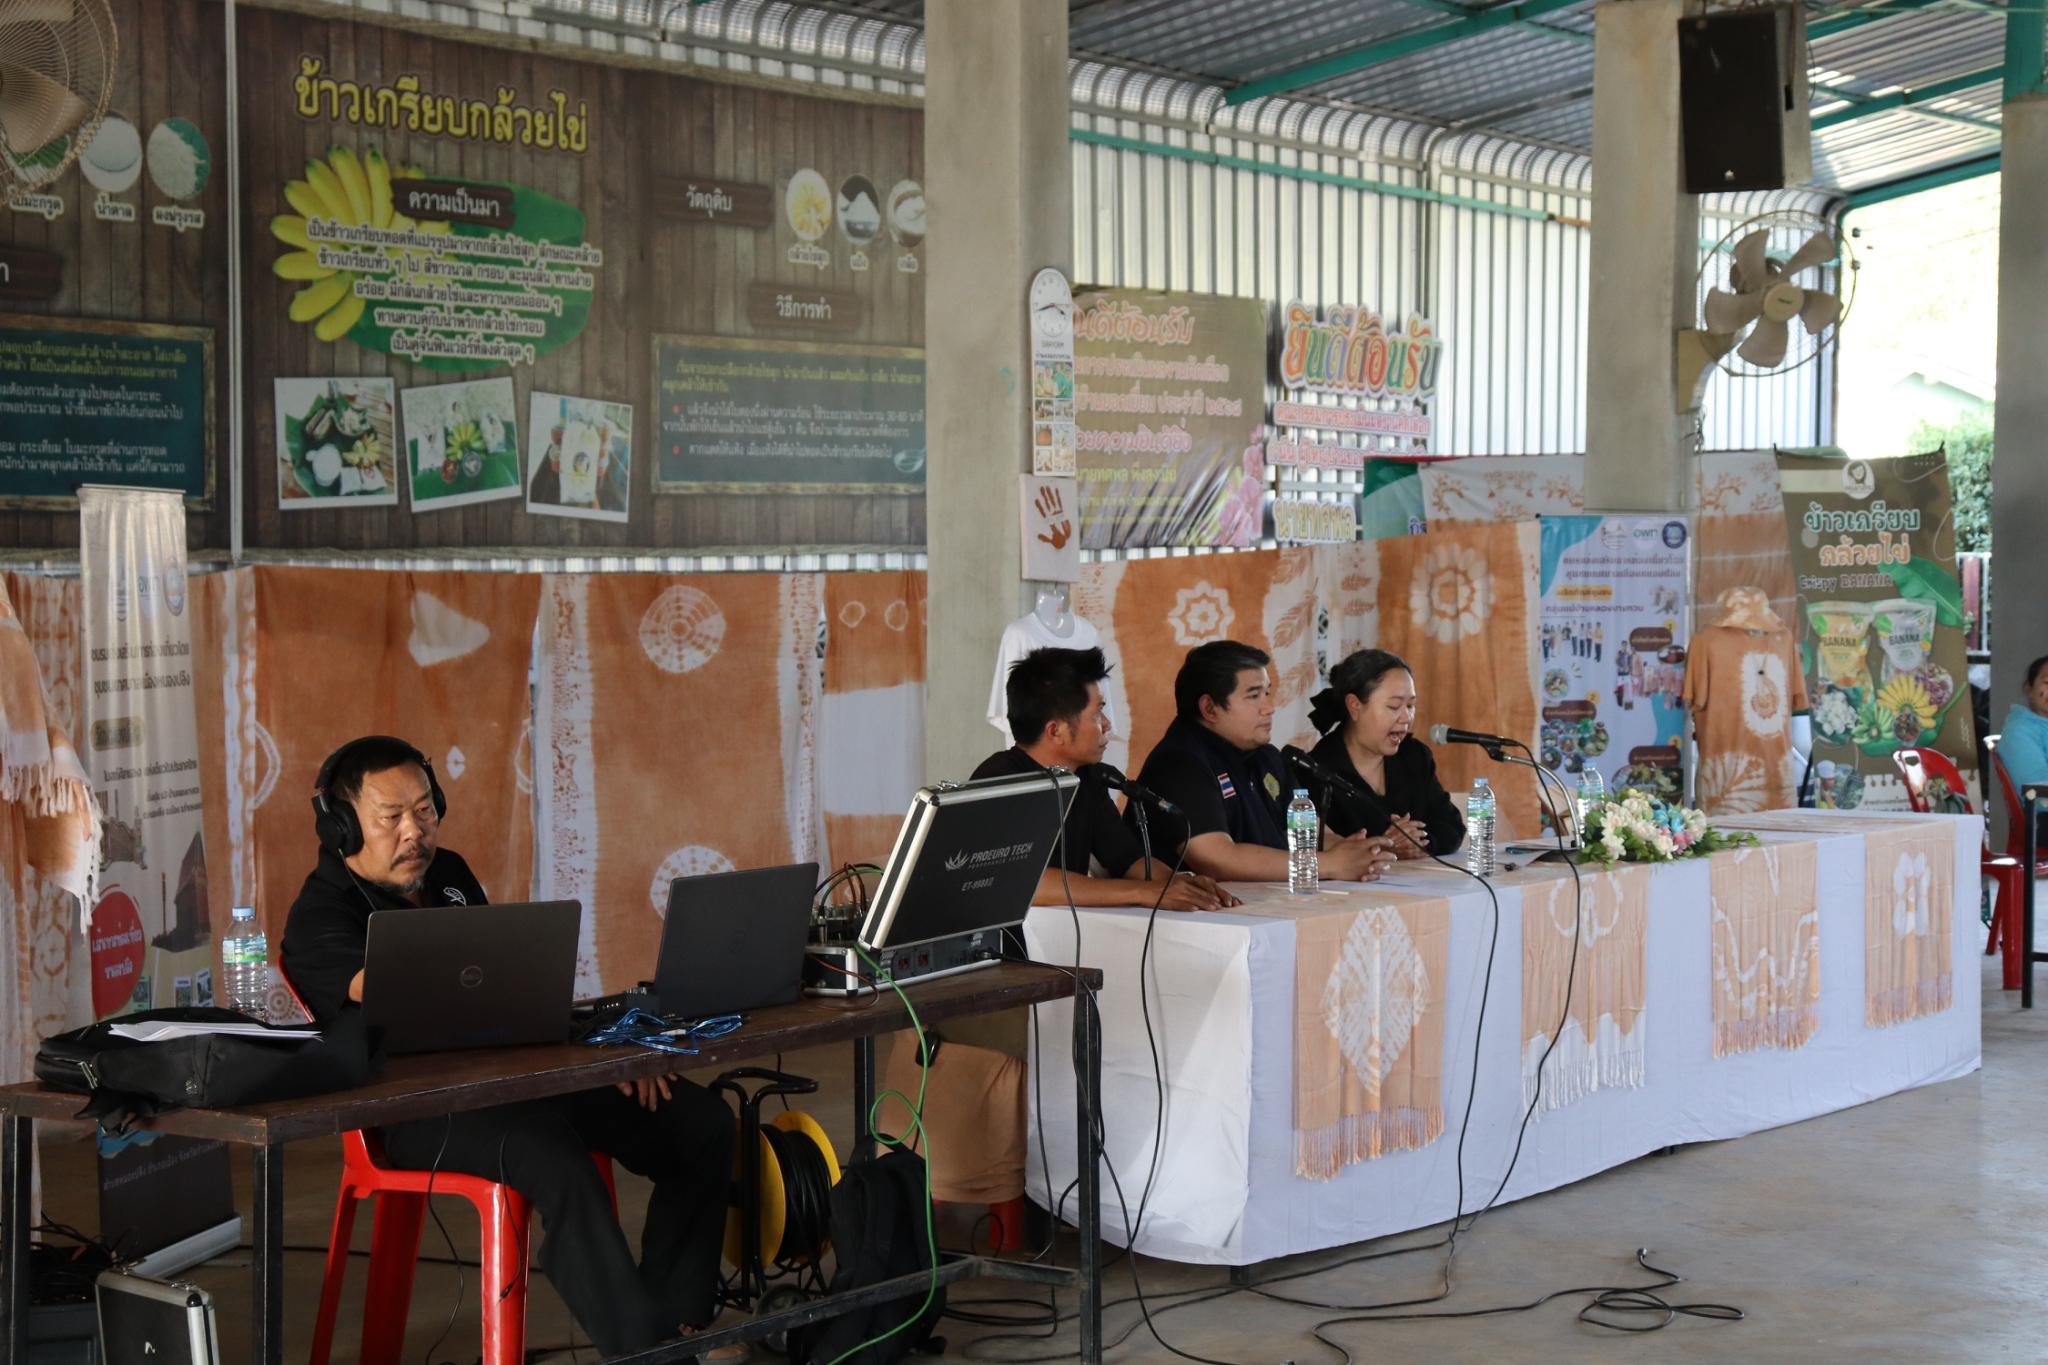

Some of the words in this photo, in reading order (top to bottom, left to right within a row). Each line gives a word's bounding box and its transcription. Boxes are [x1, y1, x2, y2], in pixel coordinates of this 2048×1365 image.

[295, 57, 588, 152] ข้าวเกรียบกล้วยไข่
[97, 193, 133, 218] น้ำตาล
[409, 187, 500, 218] ความเป็นมา
[686, 184, 732, 218] วัตถุดิบ
[155, 208, 202, 230] ผงปรุงรส
[405, 252, 419, 273] ไป
[477, 266, 505, 280] กรอบ
[554, 268, 592, 288] ทานง่าย
[356, 278, 385, 296] อร่อย
[776, 294, 832, 319] วิธีการทำ
[1285, 305, 1442, 394] ยินดีต้อนรับ
[1275, 501, 1355, 541] นายทศพล
[1804, 501, 1920, 531] ข้าวเกรียบ
[1820, 531, 1911, 566] กล้วยไข่
[1841, 573, 1894, 588] BANANA
[1822, 636, 1857, 648] BANANA
[1888, 633, 1920, 646] BANANA
[970, 848, 1010, 863] PROEURO
[1010, 841, 1034, 856] TECH
